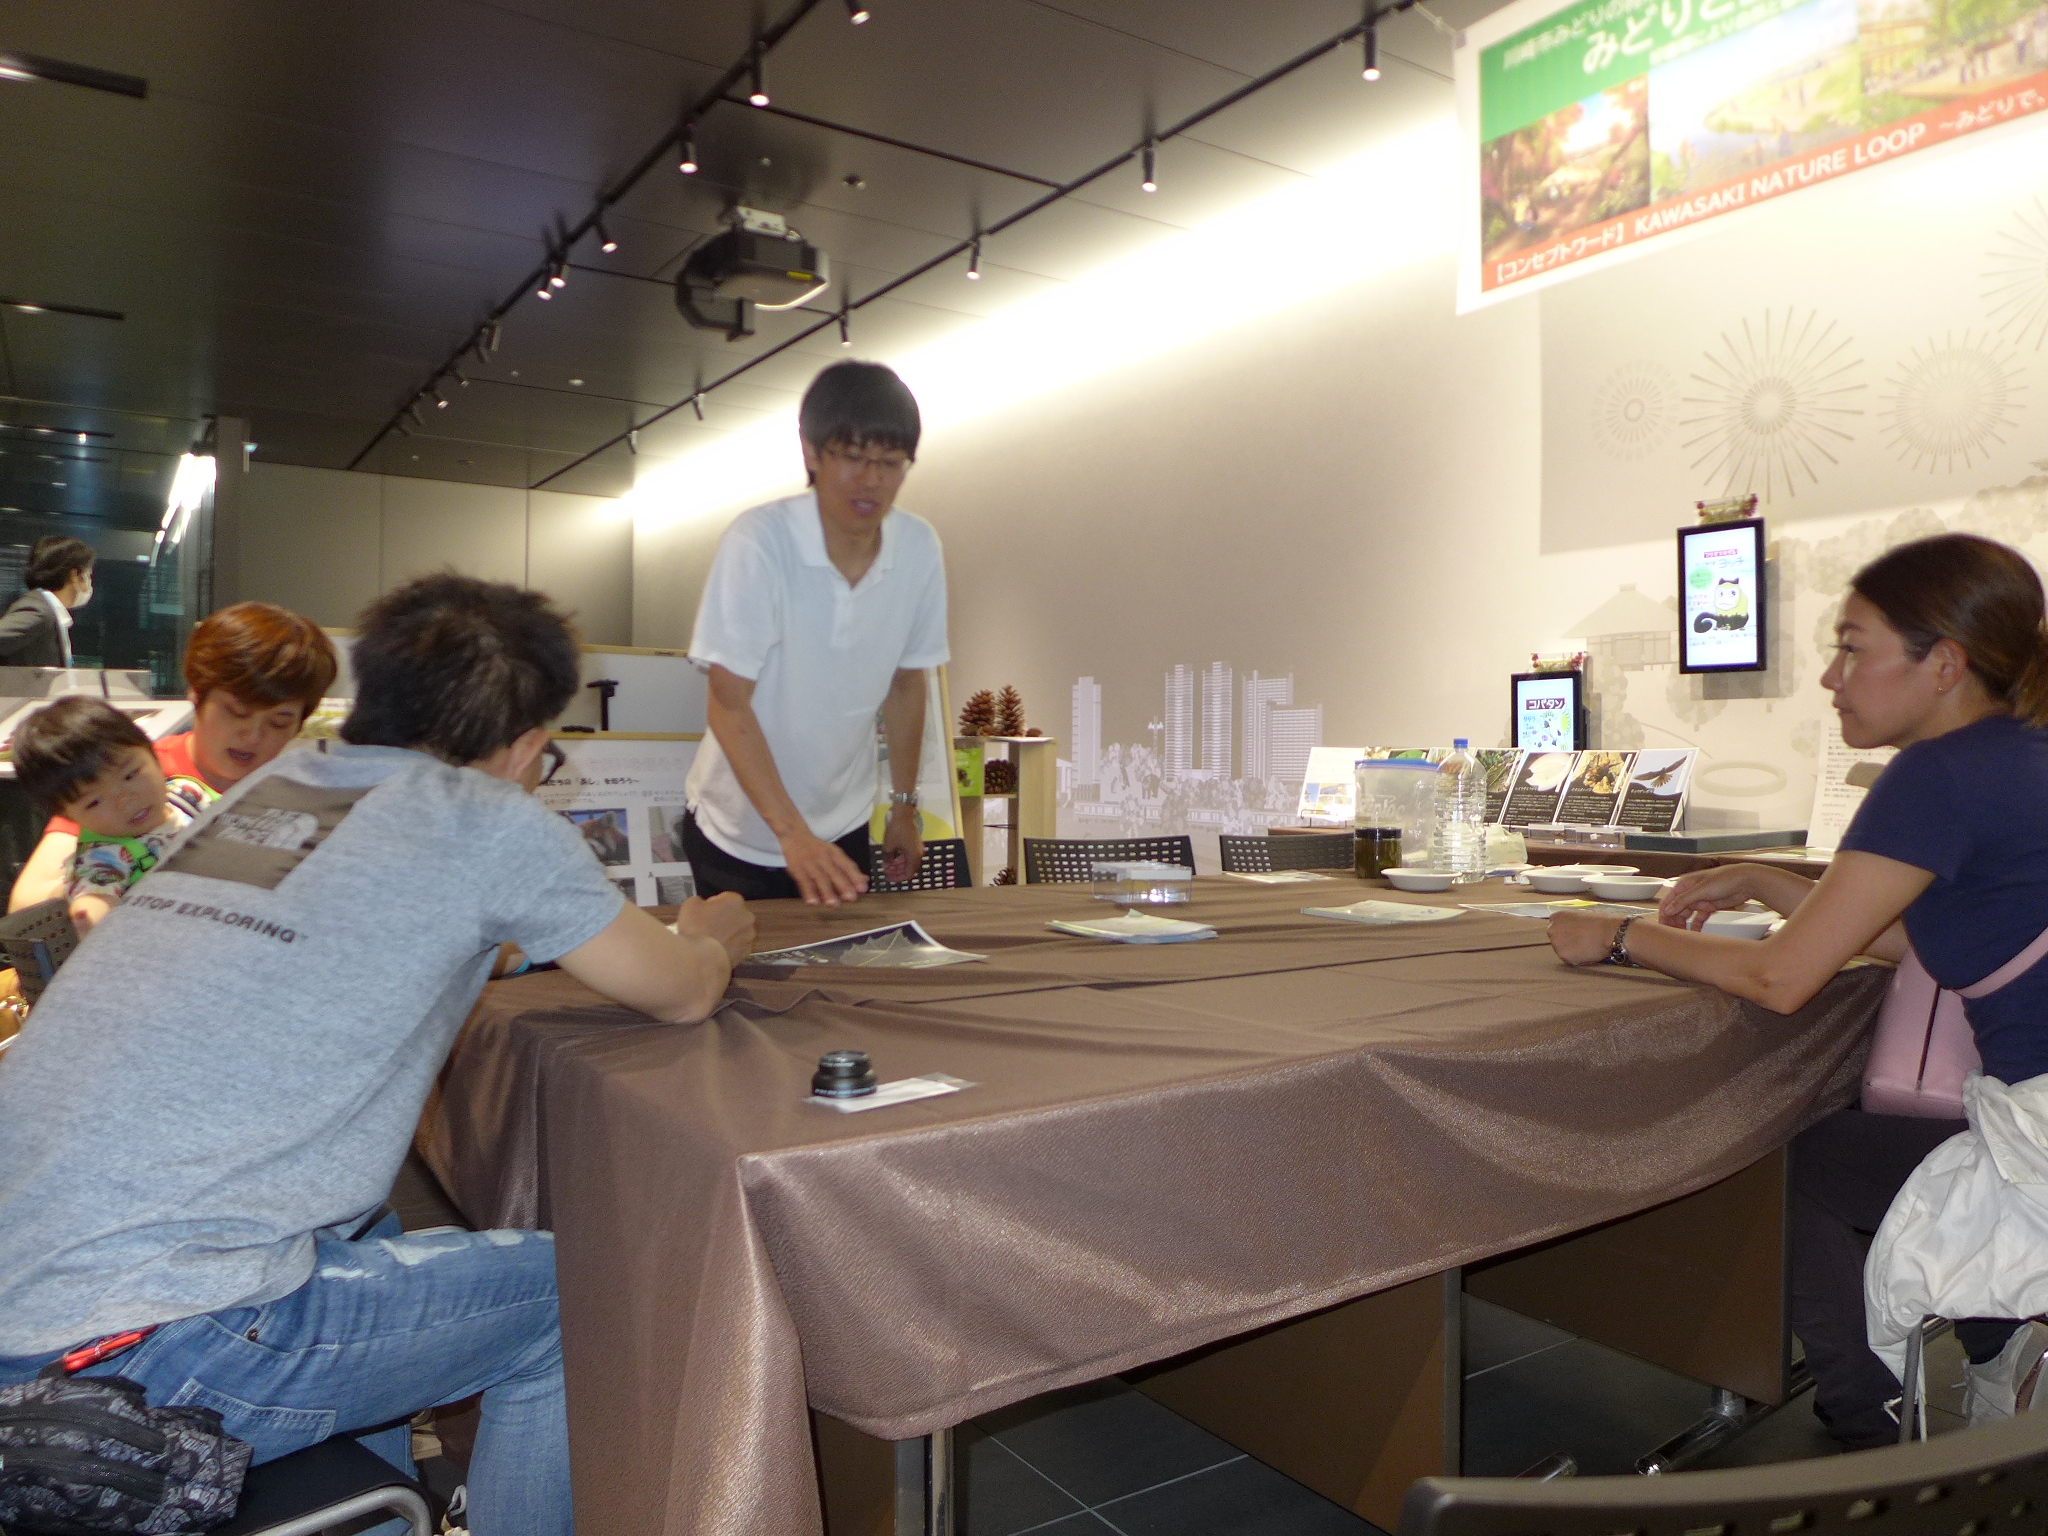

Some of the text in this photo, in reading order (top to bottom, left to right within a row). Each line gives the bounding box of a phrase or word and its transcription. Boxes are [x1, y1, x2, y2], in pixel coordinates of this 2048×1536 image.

[1634, 182, 1746, 237] KAWASAKI
[1750, 148, 1848, 199] NATURE
[1853, 121, 1927, 165] LOOP
[131, 894, 176, 911] STOP
[176, 902, 297, 943] EXPLORING
